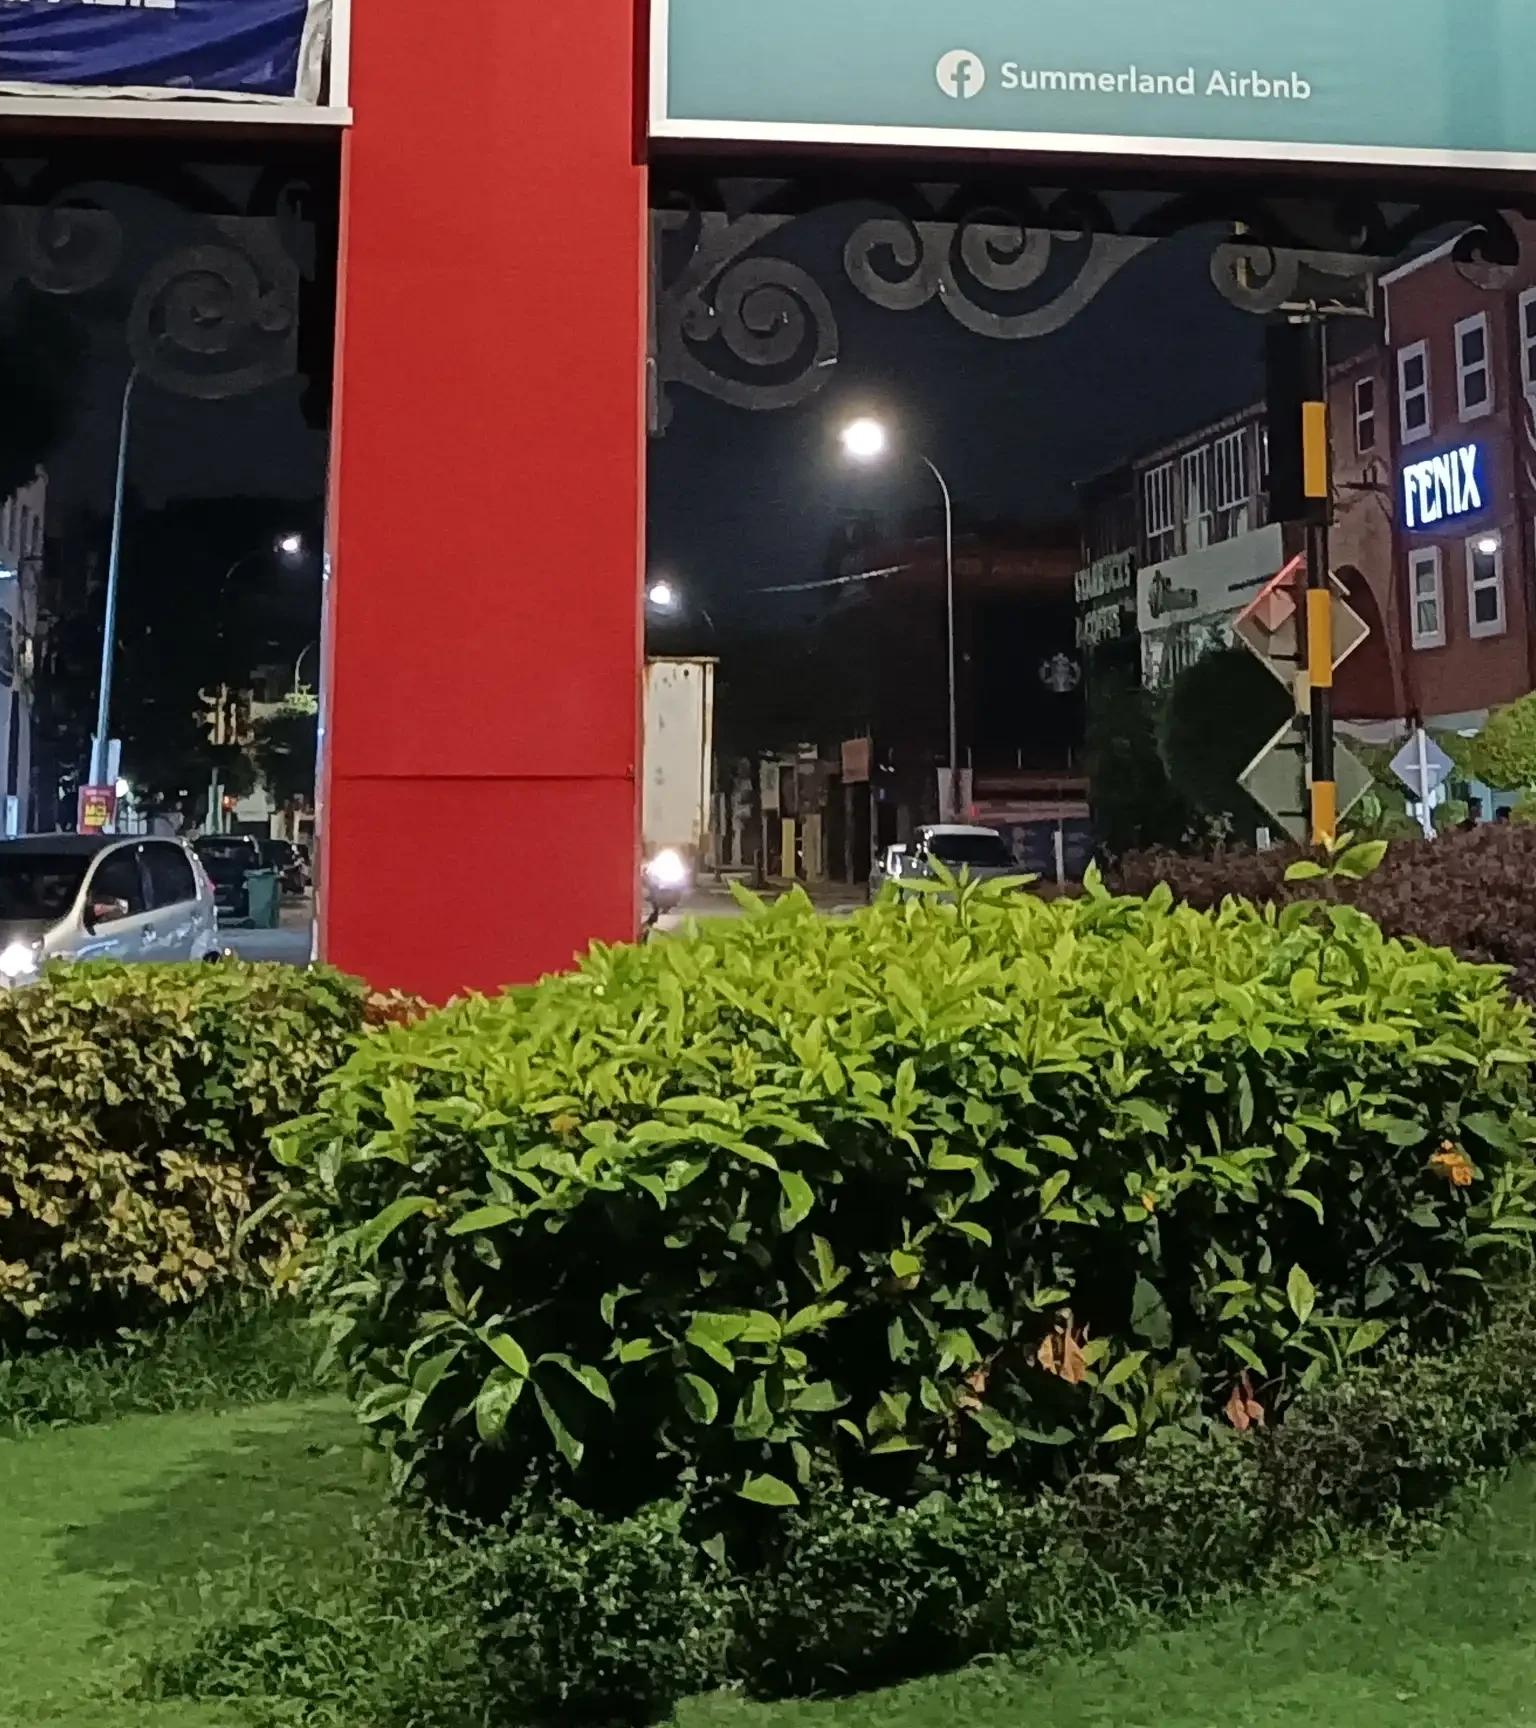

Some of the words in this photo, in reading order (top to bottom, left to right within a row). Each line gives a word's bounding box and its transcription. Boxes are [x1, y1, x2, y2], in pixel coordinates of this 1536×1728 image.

[1001, 62, 1195, 96] Summerland
[1206, 69, 1311, 100] Airbnb
[1403, 443, 1482, 528] FENIX
